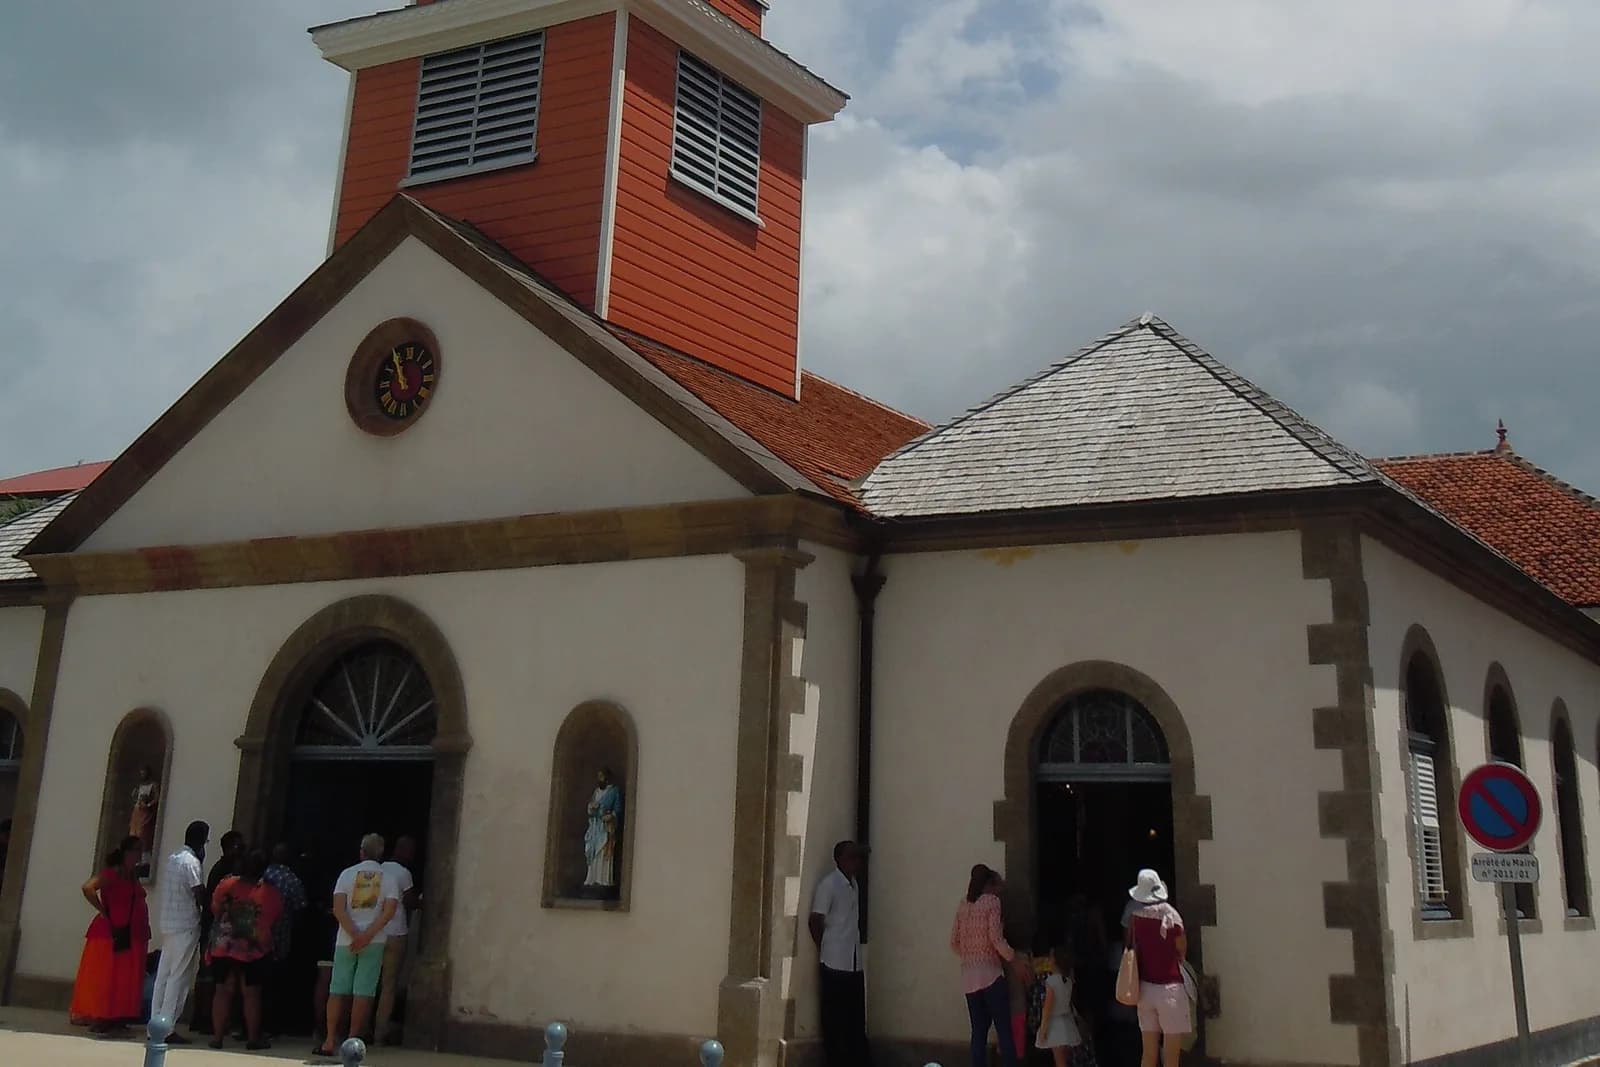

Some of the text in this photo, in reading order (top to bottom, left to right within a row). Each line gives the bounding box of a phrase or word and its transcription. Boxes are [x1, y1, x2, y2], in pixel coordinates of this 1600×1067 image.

[1473, 857, 1536, 867] Arrêté du Maire
